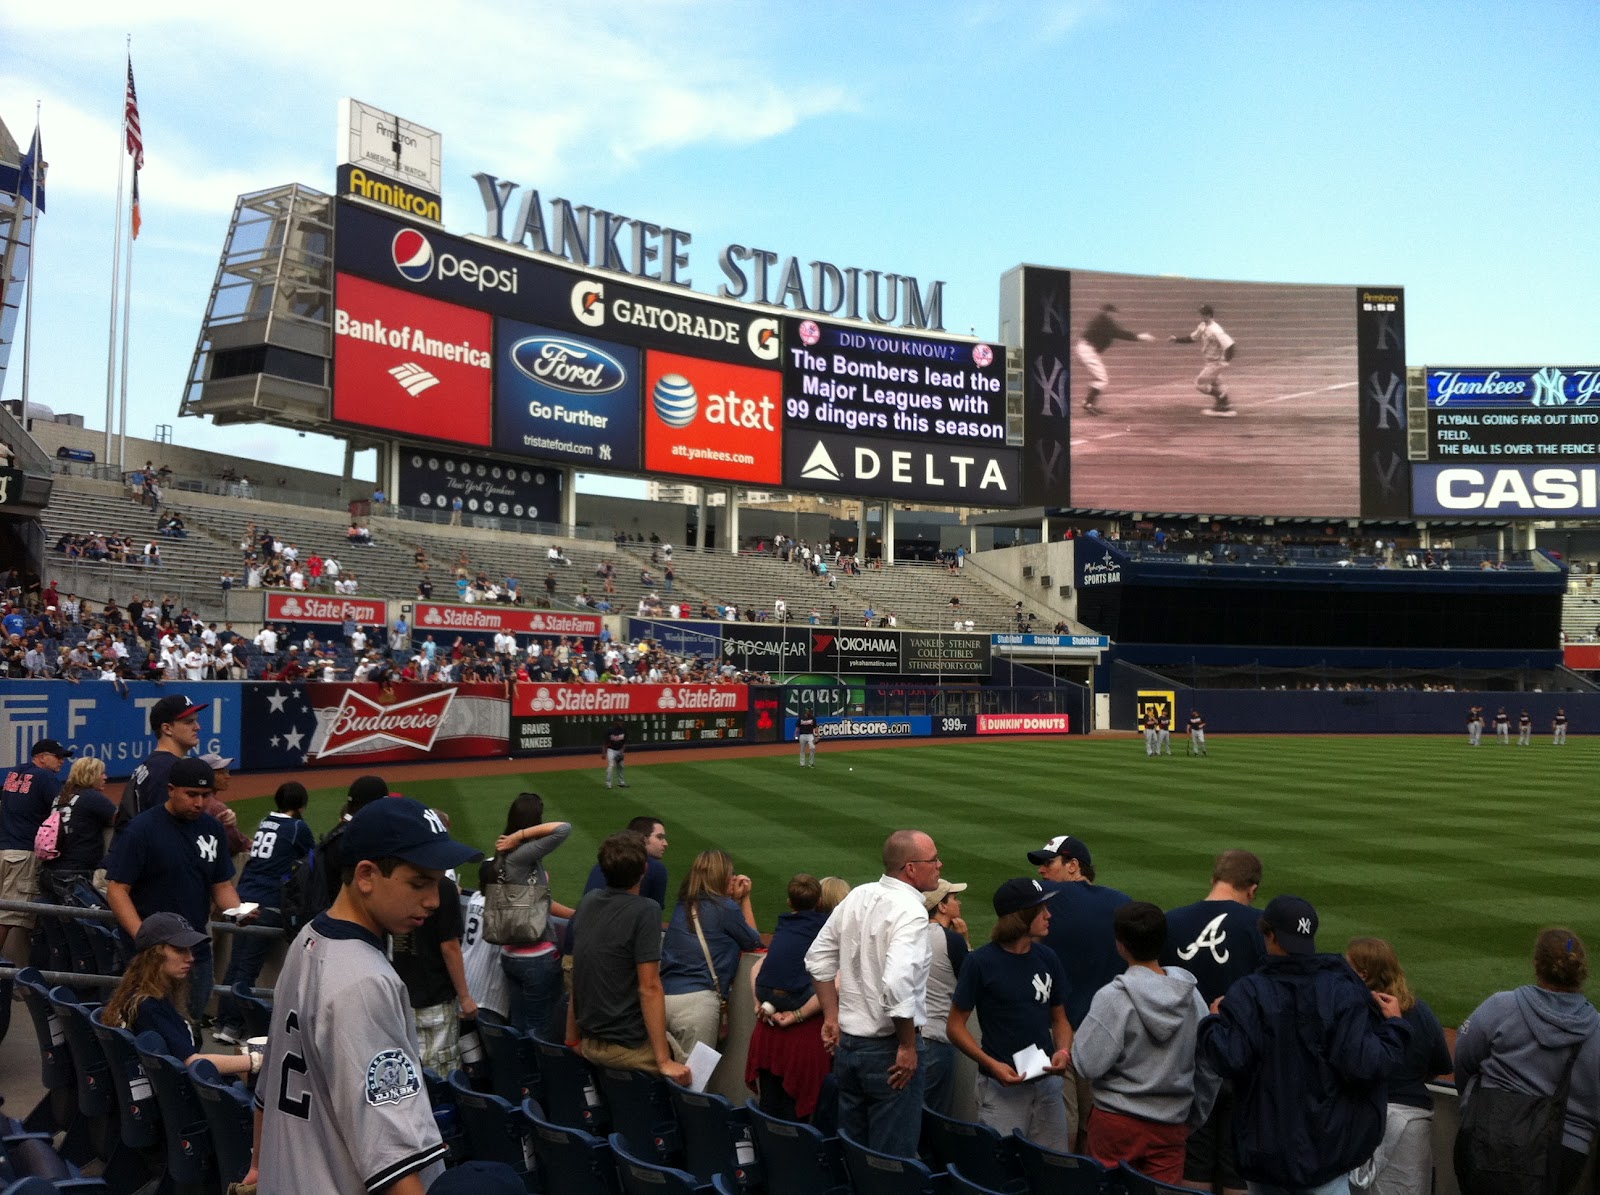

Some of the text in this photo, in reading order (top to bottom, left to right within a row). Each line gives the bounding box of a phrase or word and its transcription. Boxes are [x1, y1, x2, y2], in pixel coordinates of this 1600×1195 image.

[376, 122, 417, 148] Armtron
[350, 168, 440, 221] Armitron
[471, 172, 947, 331] YANKEE STADIUM
[438, 253, 518, 293] pepsi
[613, 299, 740, 345] GATORADE
[335, 309, 491, 369] Bank of America
[839, 332, 956, 361] DID YOU KNOW?
[533, 343, 604, 388] Ford
[791, 348, 1001, 392] The Bombers lead the
[803, 375, 989, 414] Major Leagues with
[1434, 371, 1526, 406] Yankees
[529, 401, 608, 429] Go Further
[705, 390, 774, 431] at&t
[787, 398, 1004, 439] 99 dingers this season
[1437, 414, 1599, 425] FLYBALL GOING FAR OUT INTO
[523, 434, 593, 456] tristateford.com
[1438, 430, 1471, 440] FIELD.
[1438, 444, 1595, 454] THE BALL IS OVER THE FENCE
[671, 445, 754, 465] att.yankees.com
[854, 446, 1007, 491] DELTA
[1436, 468, 1597, 510] CASI
[1084, 571, 1121, 585] SPORTS BAR
[737, 640, 806, 656] ROCAWEAR
[833, 637, 897, 652] YOKOHAMA
[917, 648, 974, 658] COLLECTIBLES
[1033, 636, 1060, 645] StubHub!
[1072, 636, 1099, 645] StubHub!
[320, 705, 449, 736] Budweiser
[521, 723, 550, 736] BRAVES
[671, 730, 685, 740] BALL
[700, 729, 718, 739] STRIKE
[728, 729, 738, 737] OUT
[685, 720, 695, 728] BAT
[716, 718, 727, 727] POS
[988, 717, 1065, 730] DUNKIN' DONUTS
[520, 736, 552, 749] YANKEES
[250, 831, 277, 859] 28
[277, 1008, 311, 1122] 2
